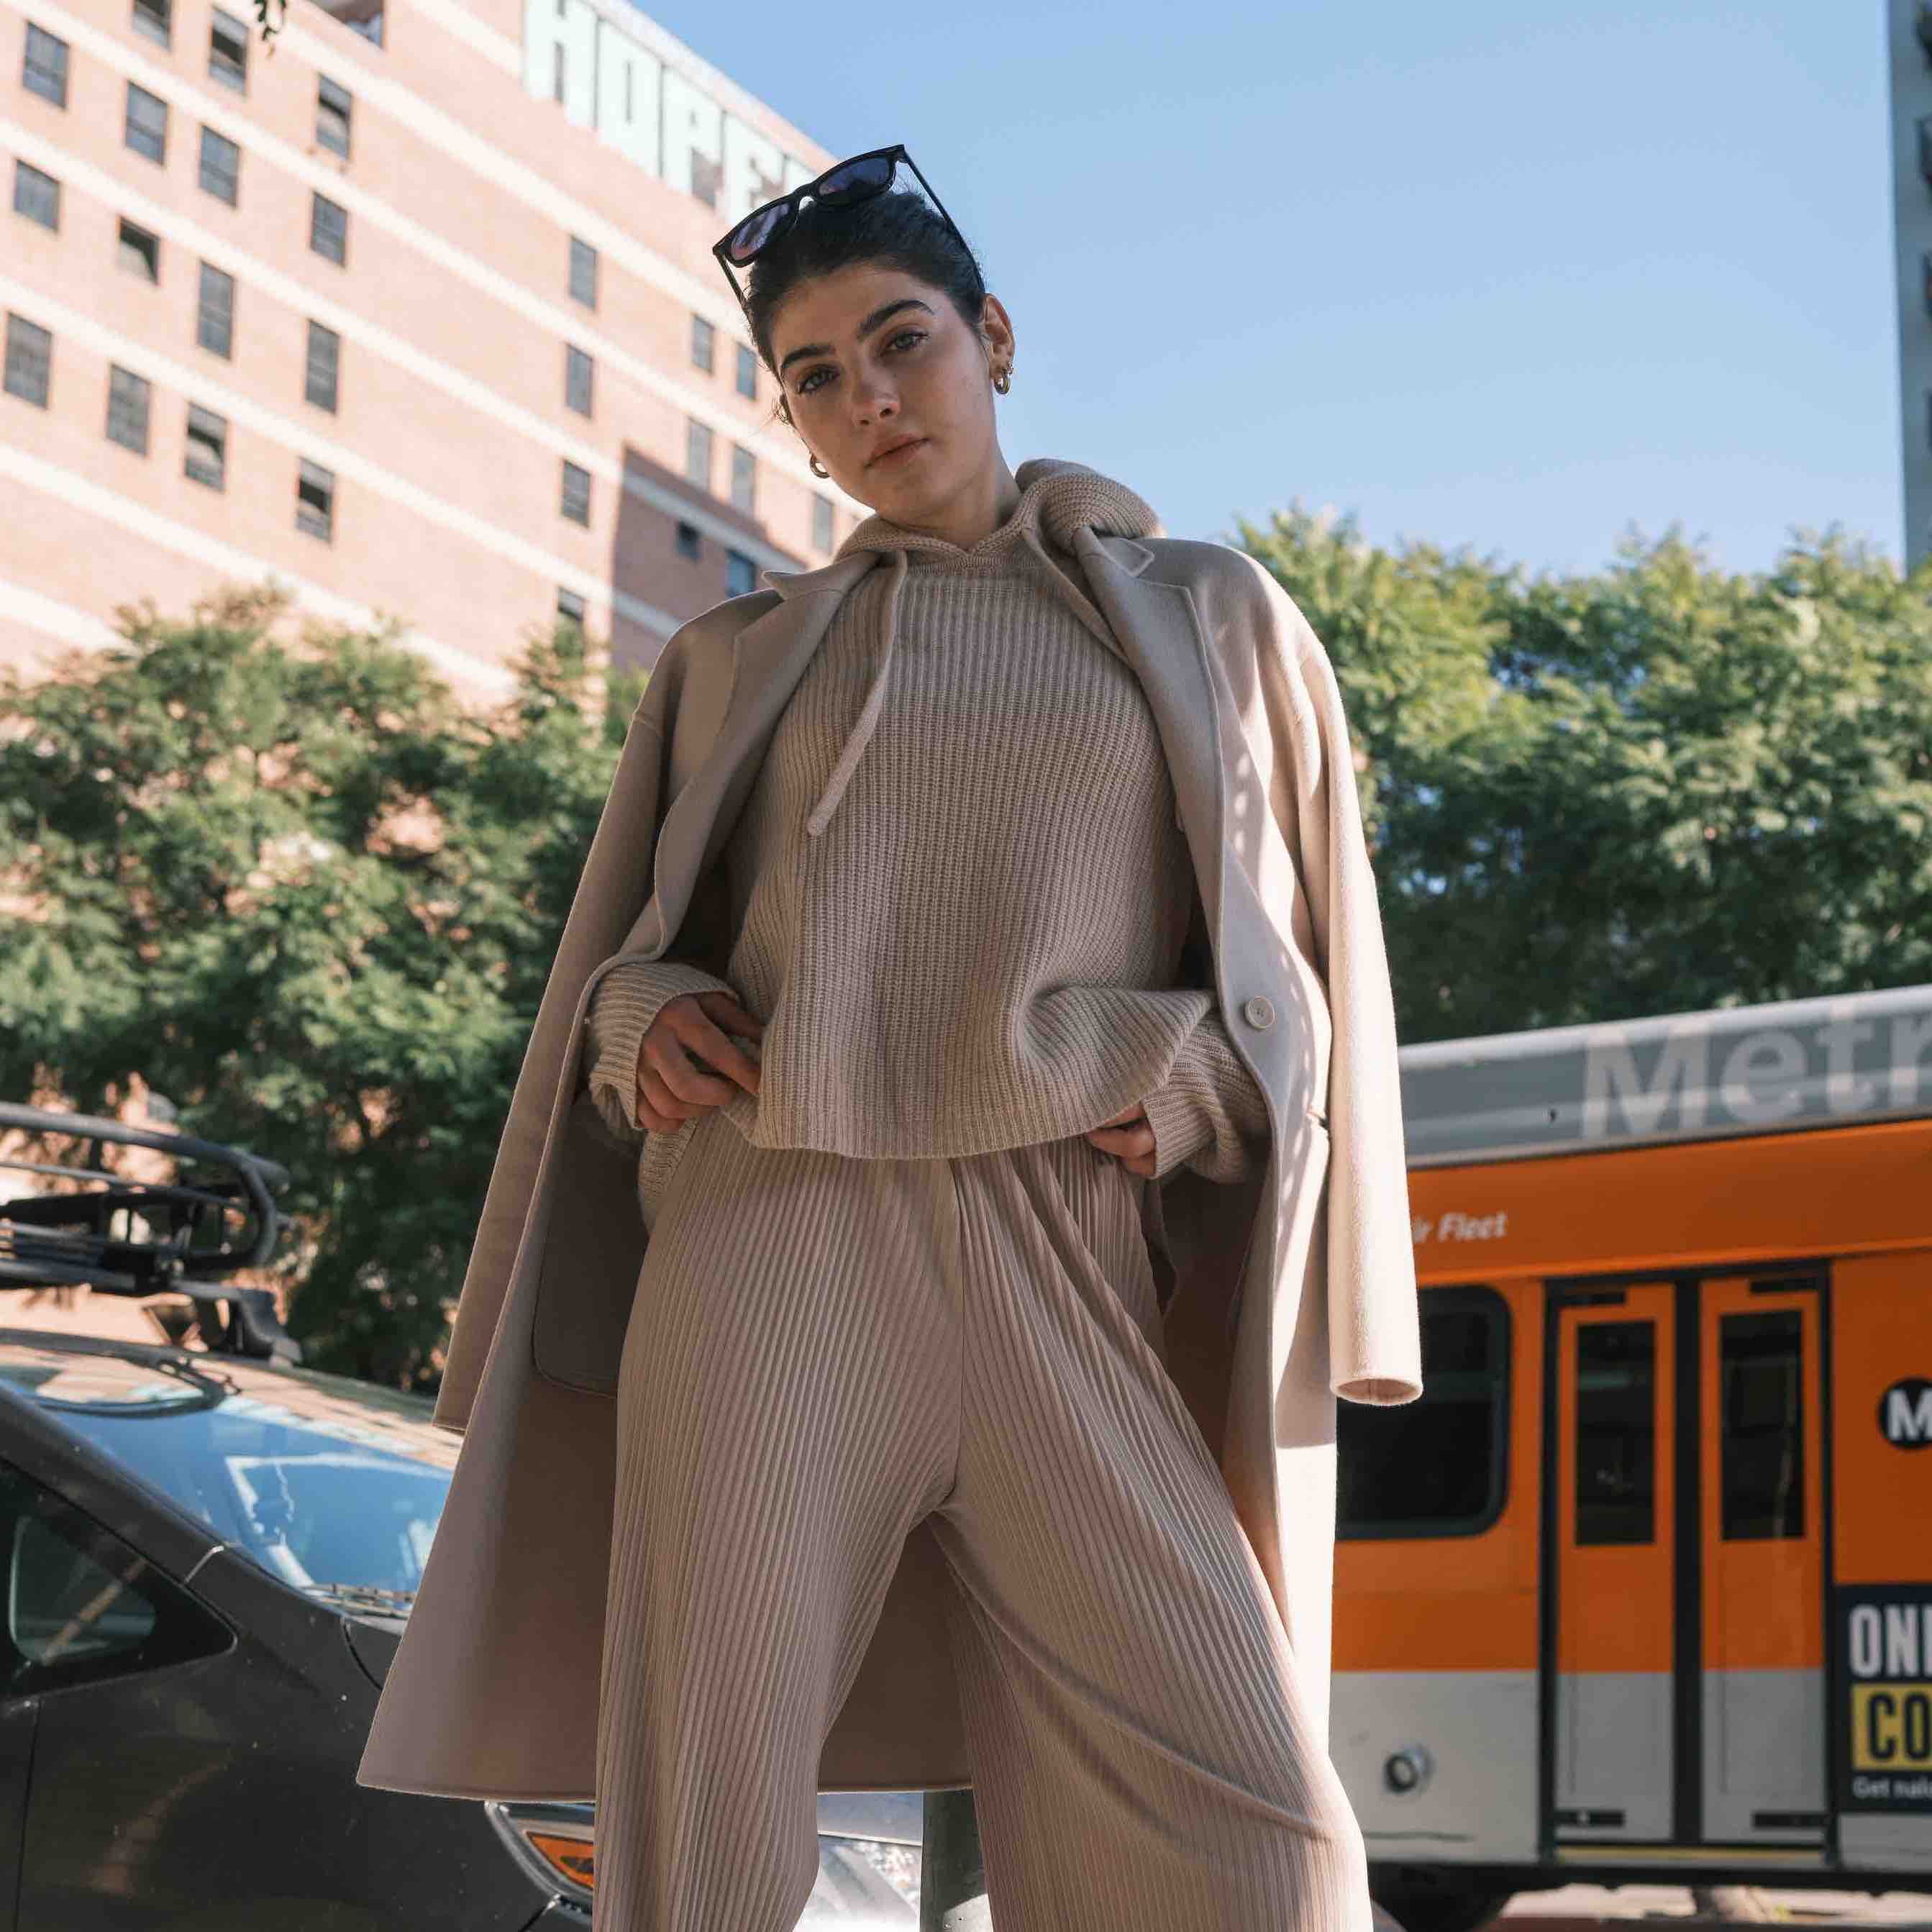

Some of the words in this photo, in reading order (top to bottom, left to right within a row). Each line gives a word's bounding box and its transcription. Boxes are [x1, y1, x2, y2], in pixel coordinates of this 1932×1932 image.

[1581, 1000, 1932, 1139] Metr
[1438, 1209, 1508, 1243] Fleet
[1888, 1389, 1932, 1441] M
